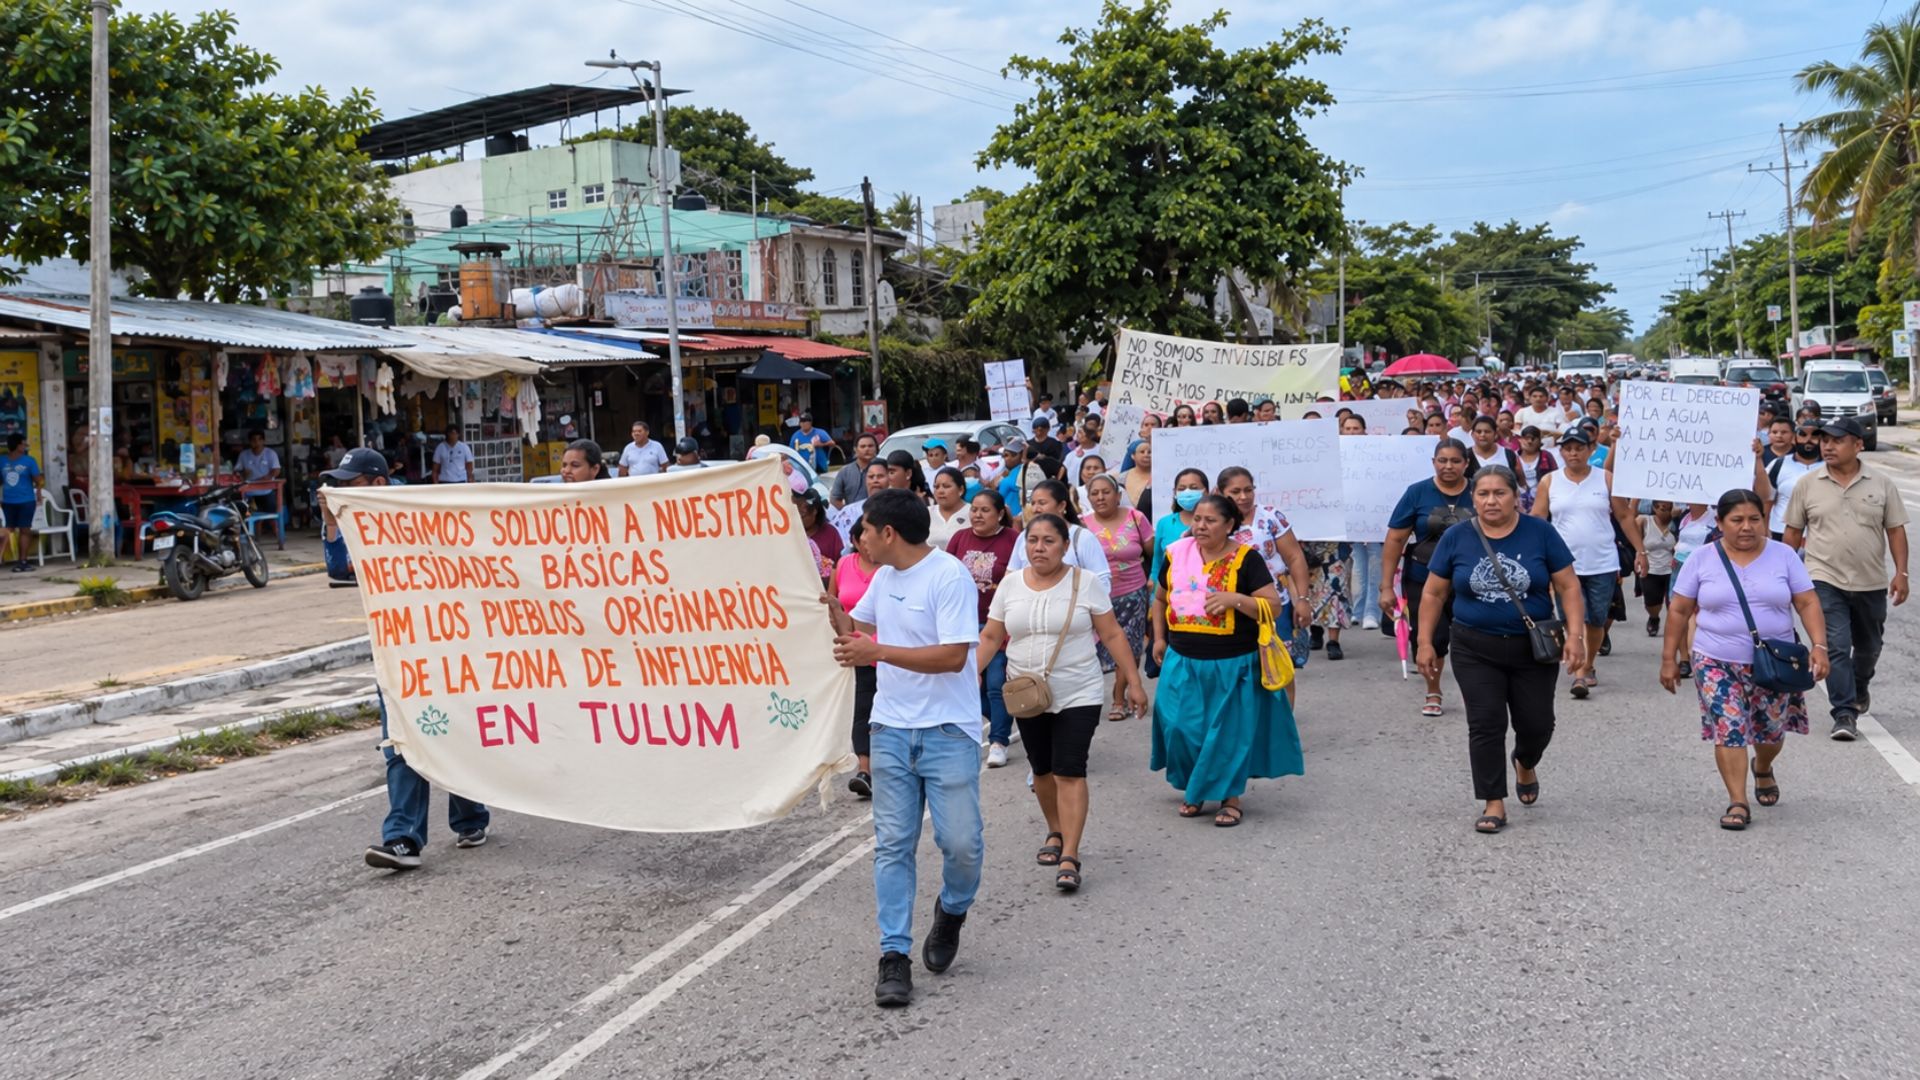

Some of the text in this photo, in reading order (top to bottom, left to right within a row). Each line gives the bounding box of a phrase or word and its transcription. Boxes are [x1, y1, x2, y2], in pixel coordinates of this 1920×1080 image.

[1127, 337, 1147, 354] NO
[1153, 341, 1204, 363] SOMOS
[1626, 384, 1751, 406] POR EL DERECHO
[1623, 405, 1710, 424] A LA AGUA
[1622, 425, 1714, 444] A LA SALUD
[1621, 446, 1744, 468] Y A LA VIVIENDA
[1646, 470, 1704, 491] DIGNA
[353, 484, 791, 547] EXIGIMOS SOLUCIÓN A NUESTRAS
[361, 546, 670, 595] NECESIDADES BÁSICAS
[369, 581, 789, 647] TAM LOS PUEBLOS ORIGINARIOS
[400, 637, 790, 699] DE LA ZONA DE INFLUENCIA
[476, 701, 740, 750] EN TULUM
